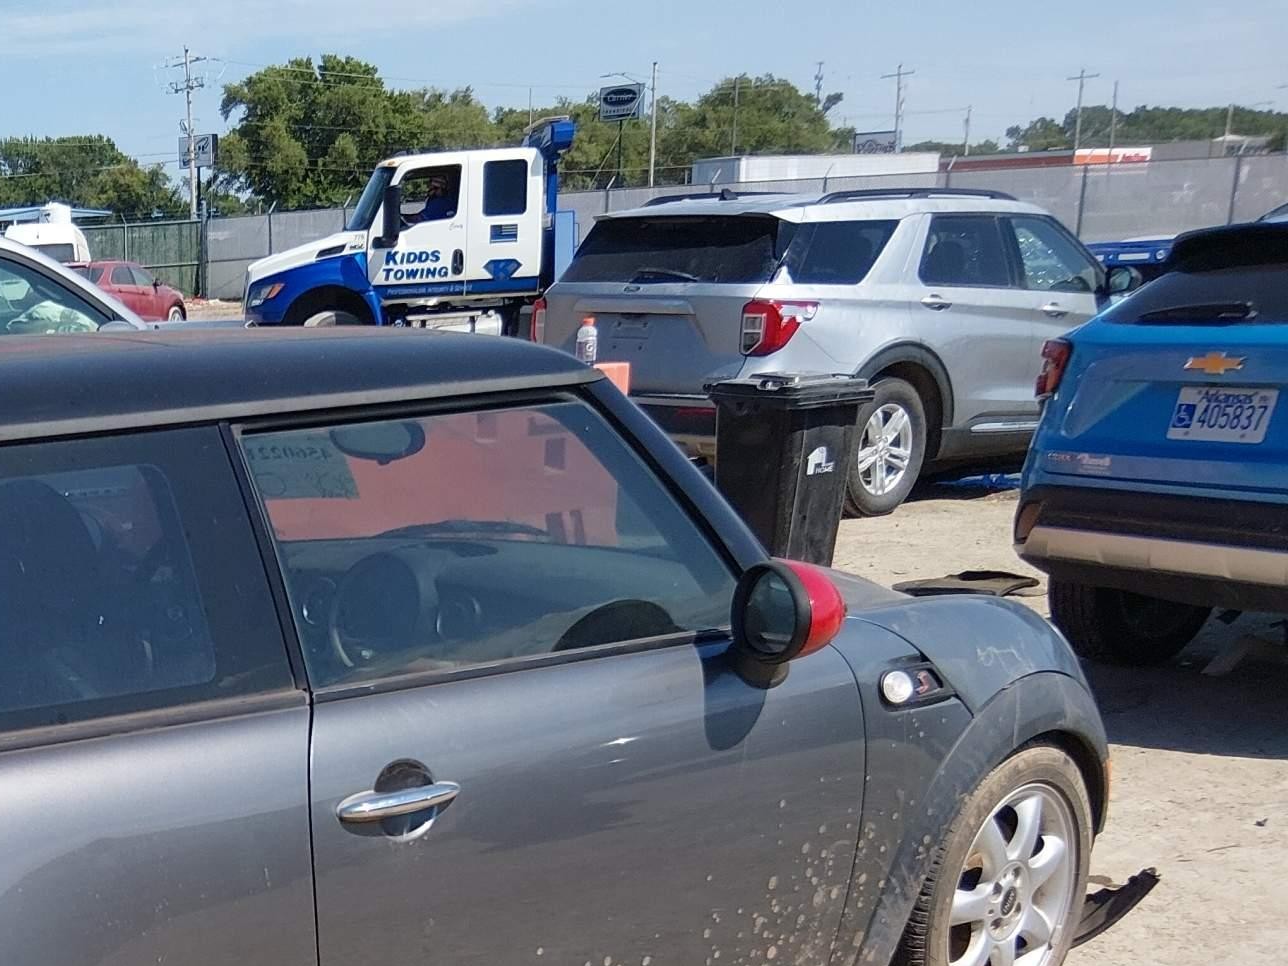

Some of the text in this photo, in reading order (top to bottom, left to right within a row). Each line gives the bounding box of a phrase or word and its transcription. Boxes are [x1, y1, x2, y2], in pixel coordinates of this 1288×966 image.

[385, 250, 441, 266] KIDDS
[383, 266, 449, 281] TOWING
[1196, 404, 1268, 431] 405837
